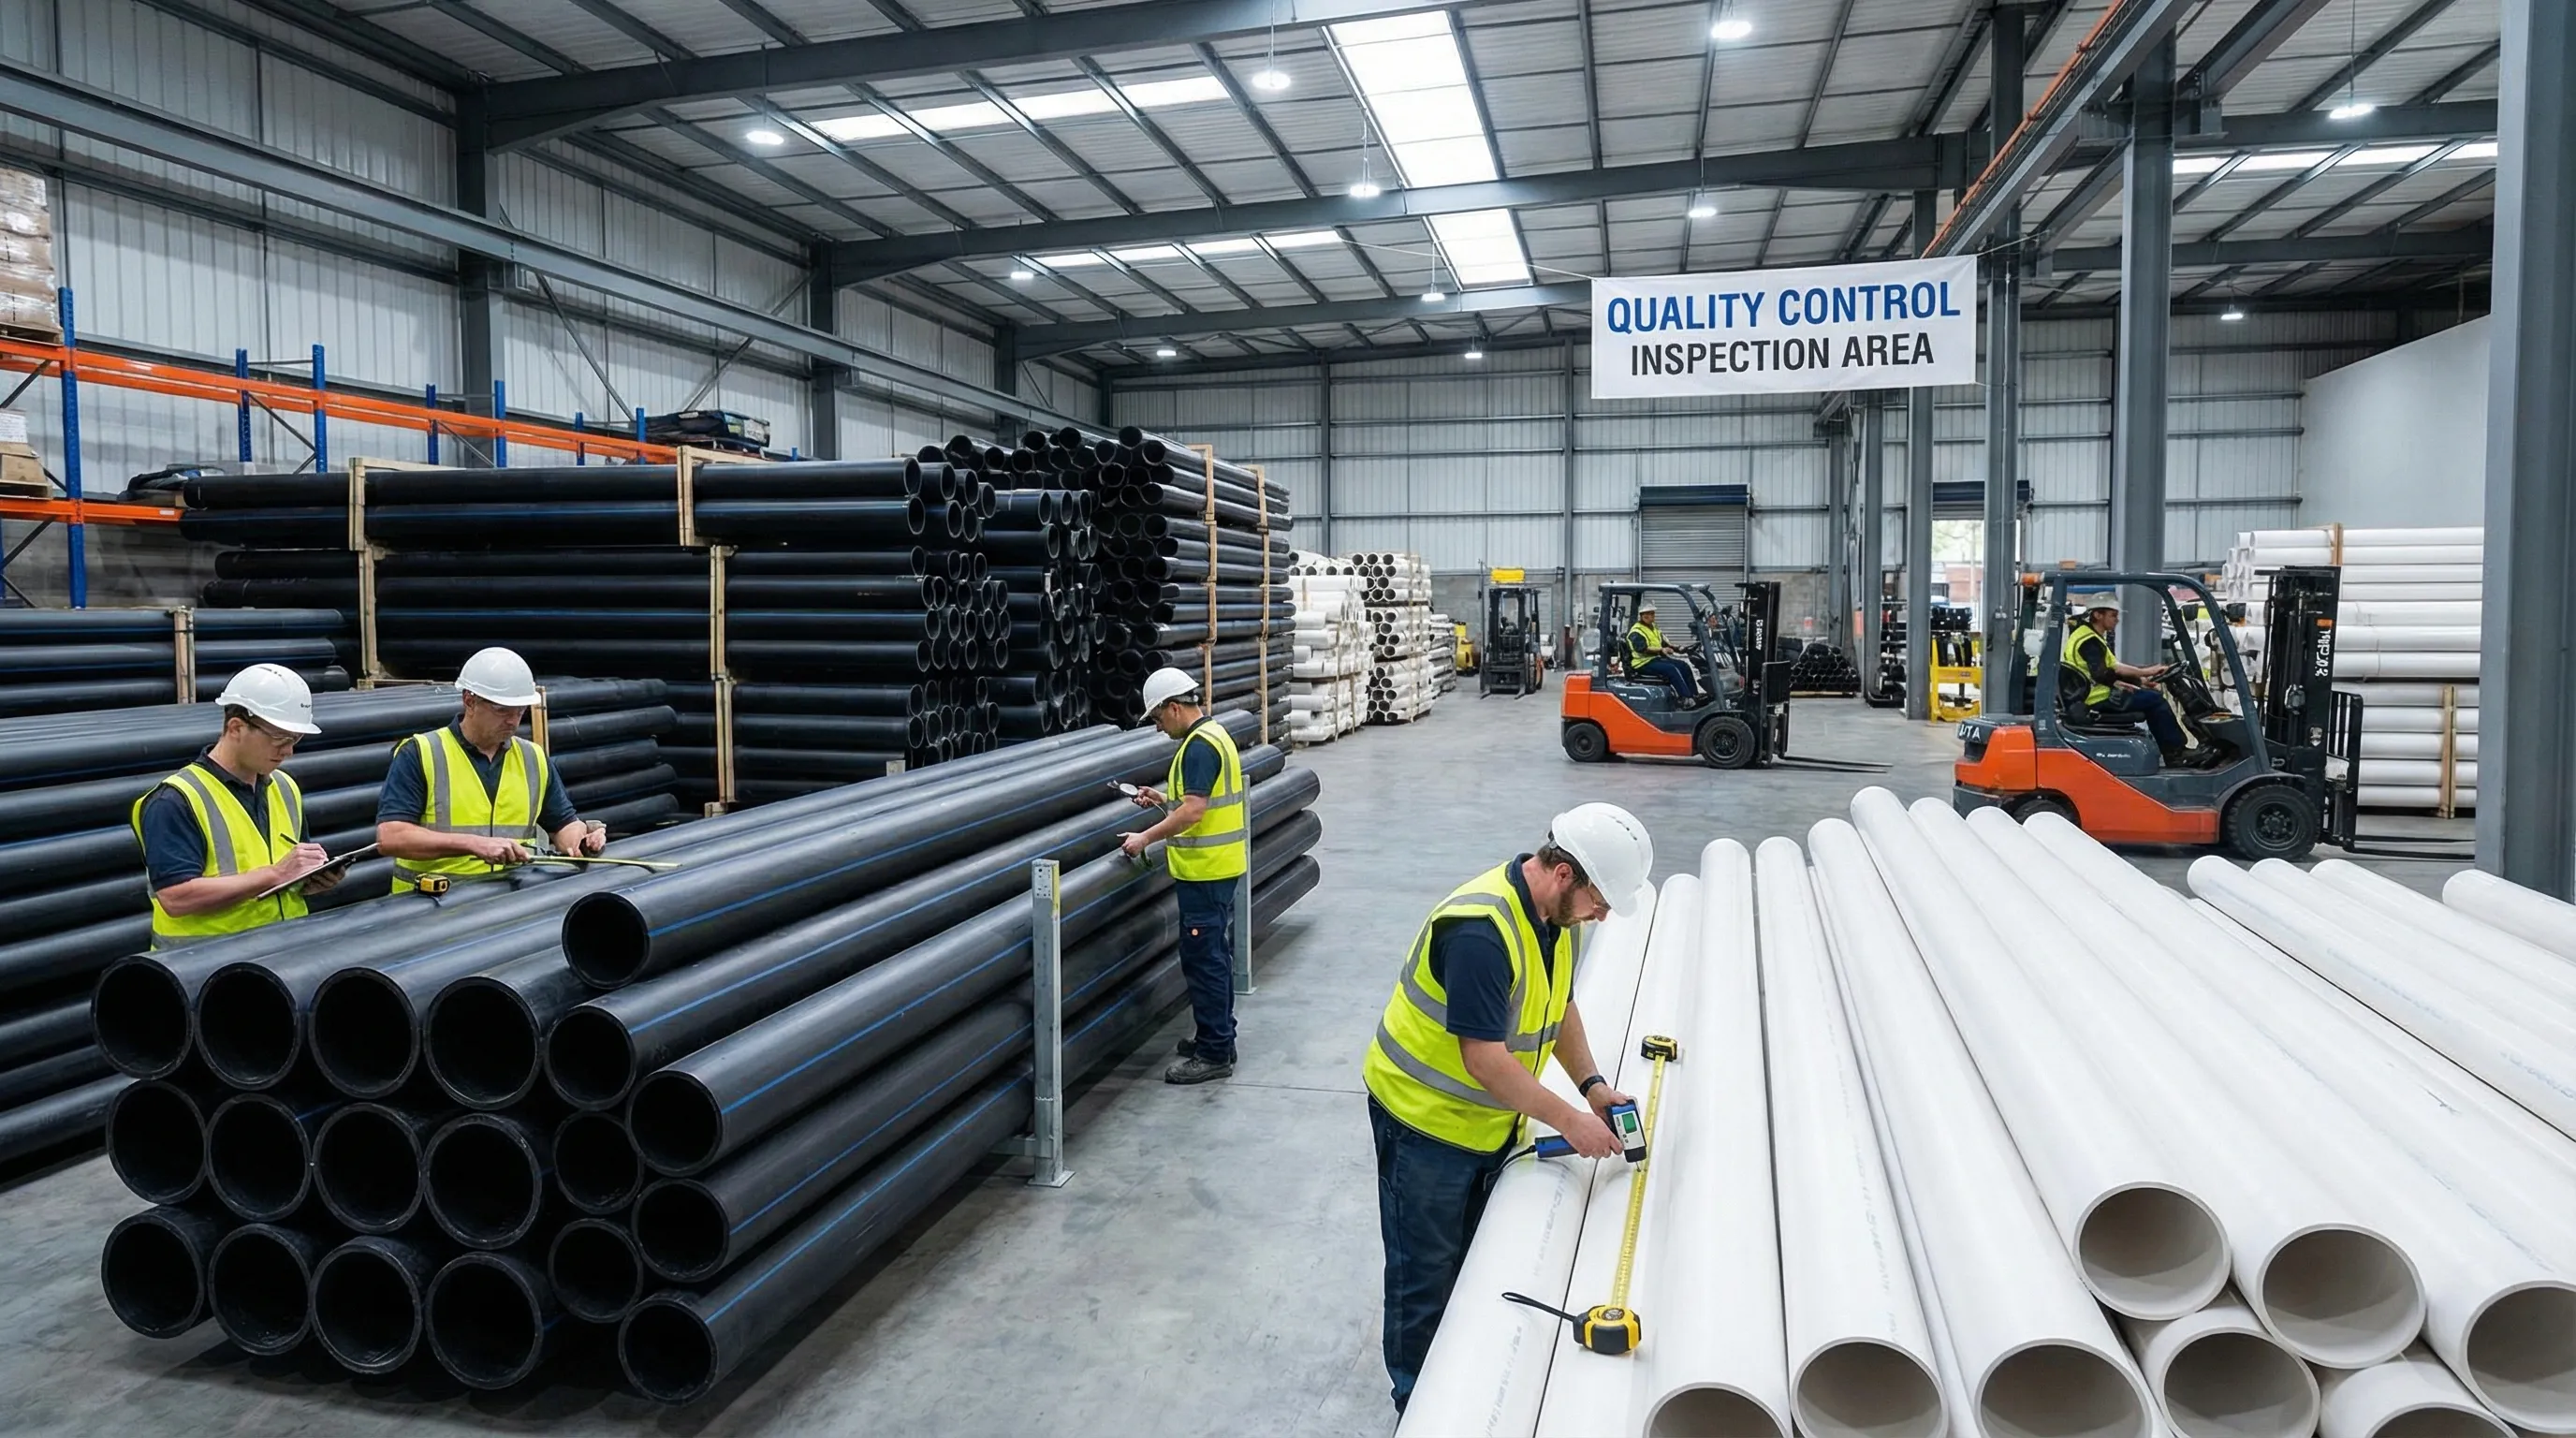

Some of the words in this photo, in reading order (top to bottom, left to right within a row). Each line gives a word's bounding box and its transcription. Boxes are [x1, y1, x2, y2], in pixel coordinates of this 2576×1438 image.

[1607, 291, 1765, 334] QUALITY
[1778, 281, 1961, 326] CONTROL
[1631, 337, 1829, 376] INSPECTION
[1841, 331, 1935, 368] AREA
